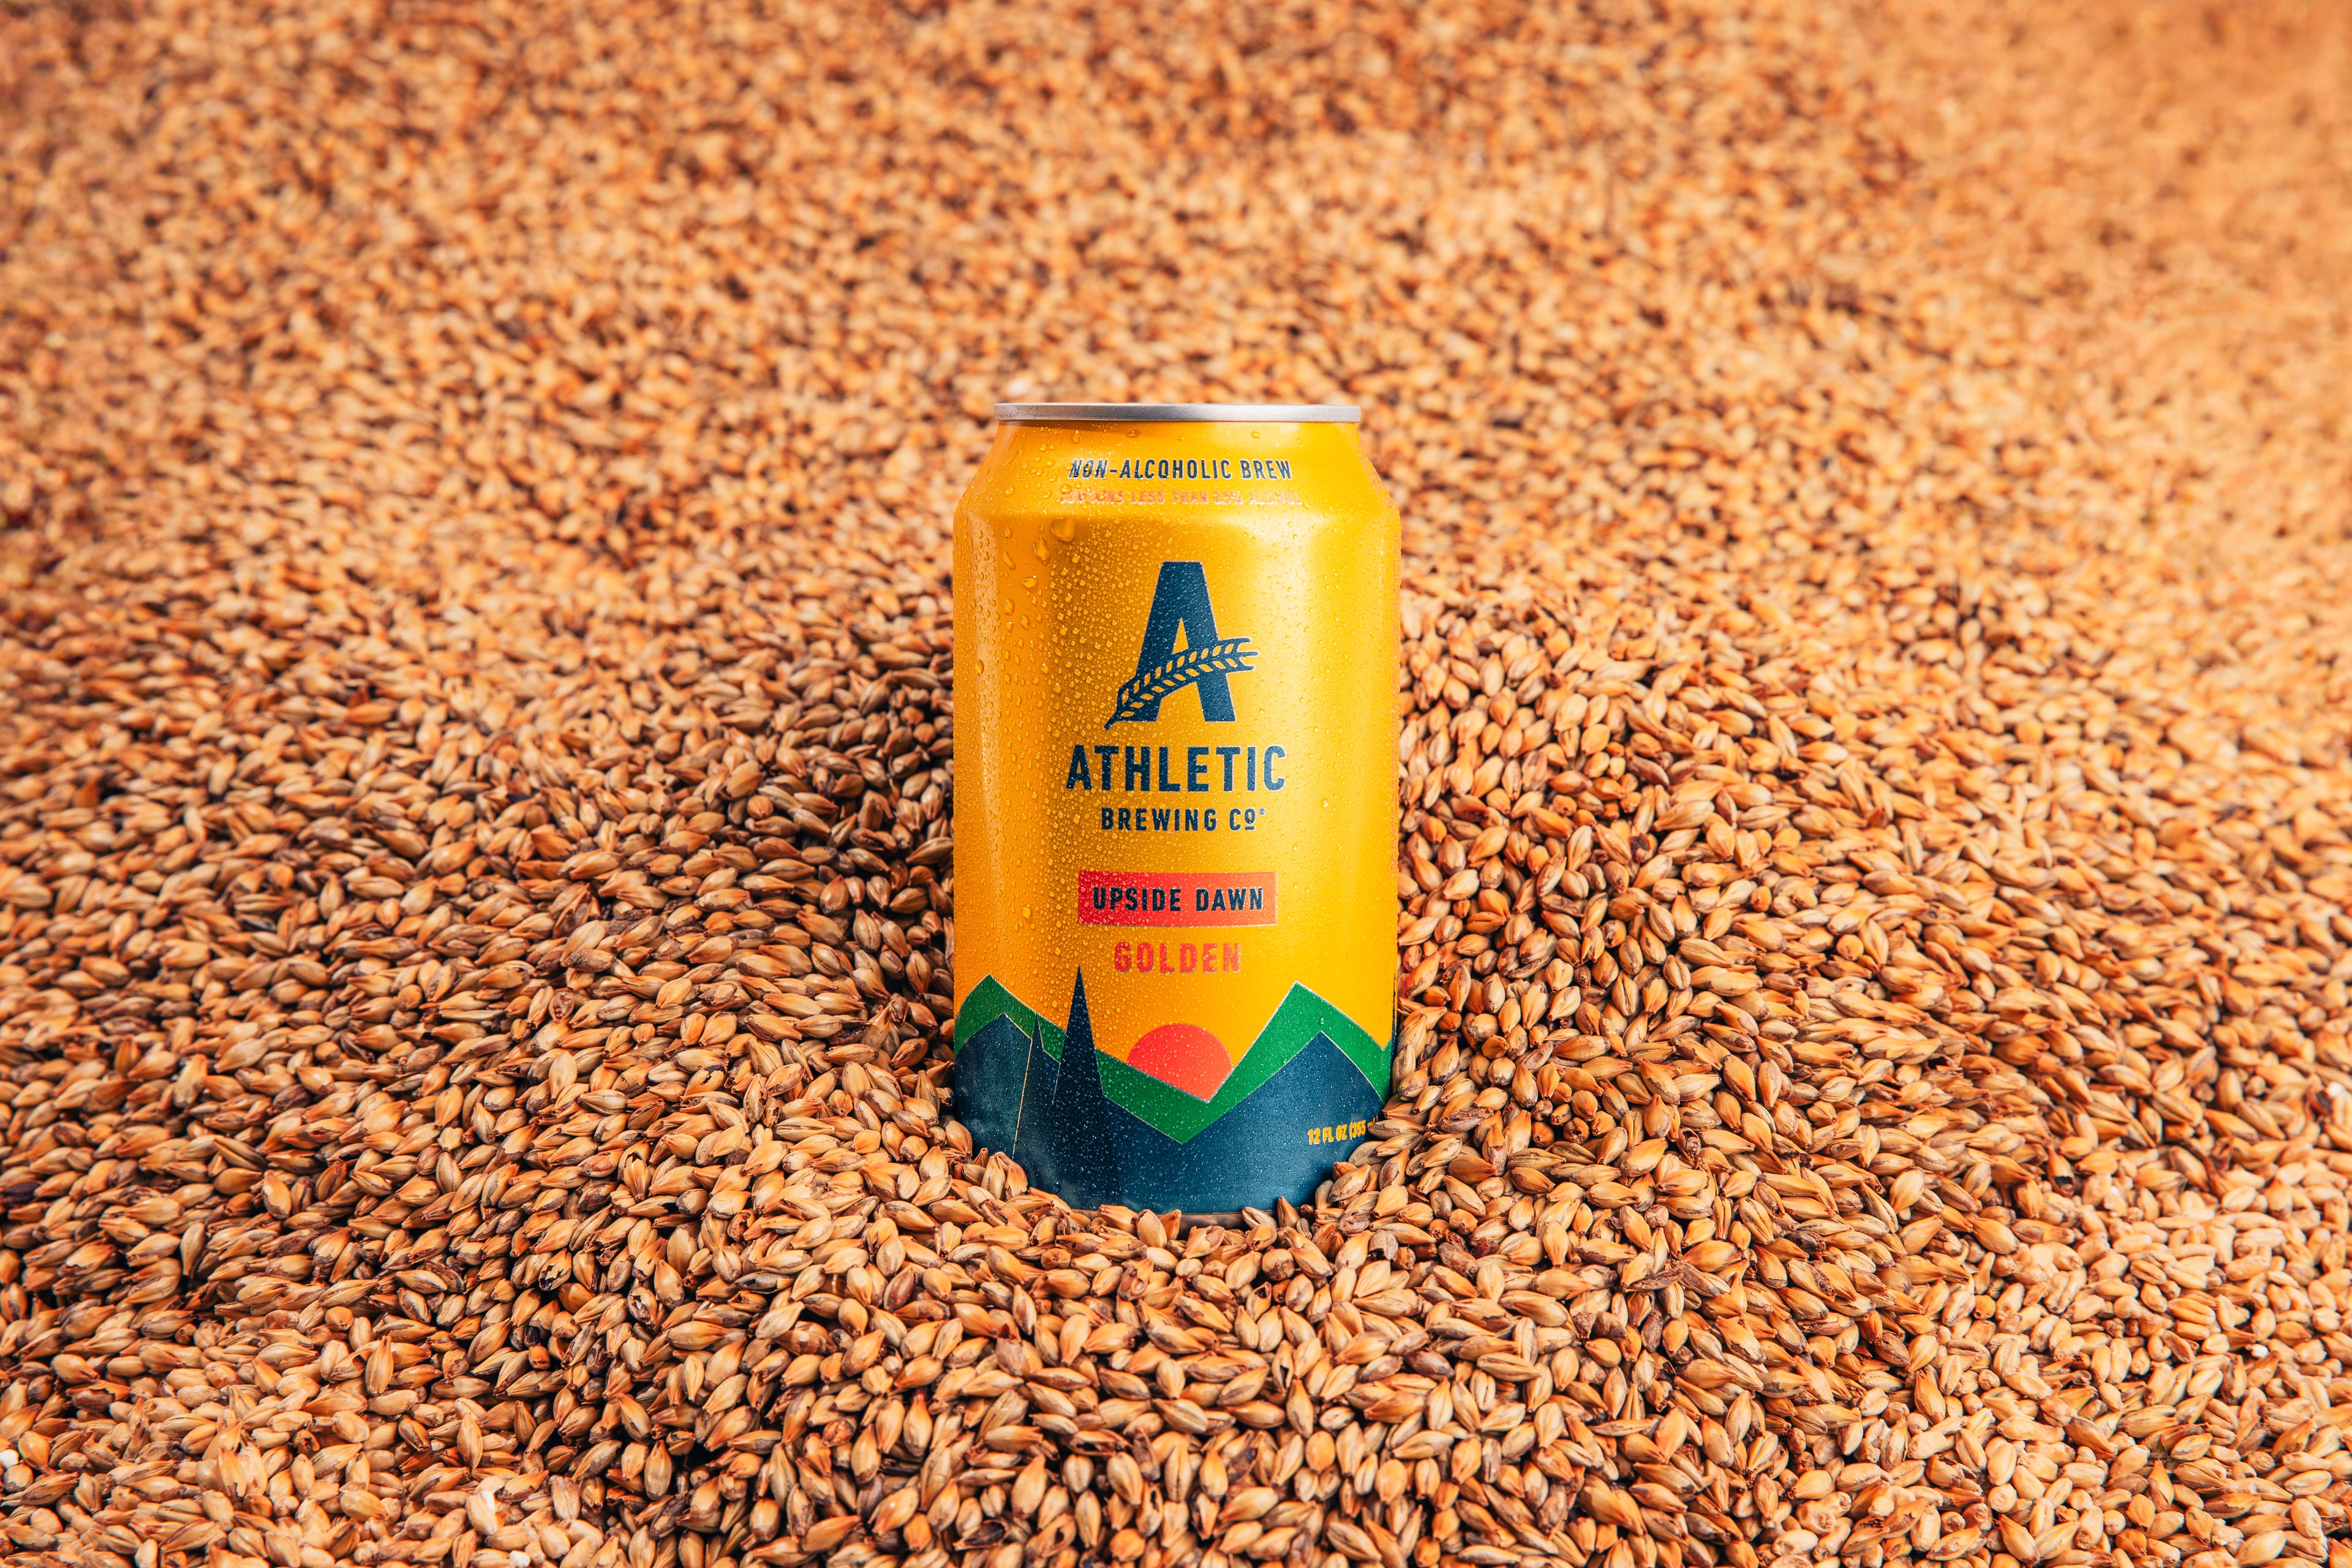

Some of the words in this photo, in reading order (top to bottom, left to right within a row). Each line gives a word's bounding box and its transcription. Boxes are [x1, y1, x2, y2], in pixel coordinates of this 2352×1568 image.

[1068, 459, 1231, 480] NON-ALCOHOLIC
[1240, 459, 1292, 480] BREW
[1131, 490, 1166, 505] LESS
[1171, 490, 1208, 505] THAN
[1066, 745, 1286, 792] ATHLETIC
[1101, 807, 1217, 831] BREWING
[1093, 886, 1182, 911] UPSIDE
[1195, 887, 1264, 911] DAWN
[1115, 941, 1242, 974] GOLDEN
[1307, 1128, 1321, 1145] 12
[1322, 1126, 1335, 1143] FL
[1336, 1124, 1348, 1141] OZ
